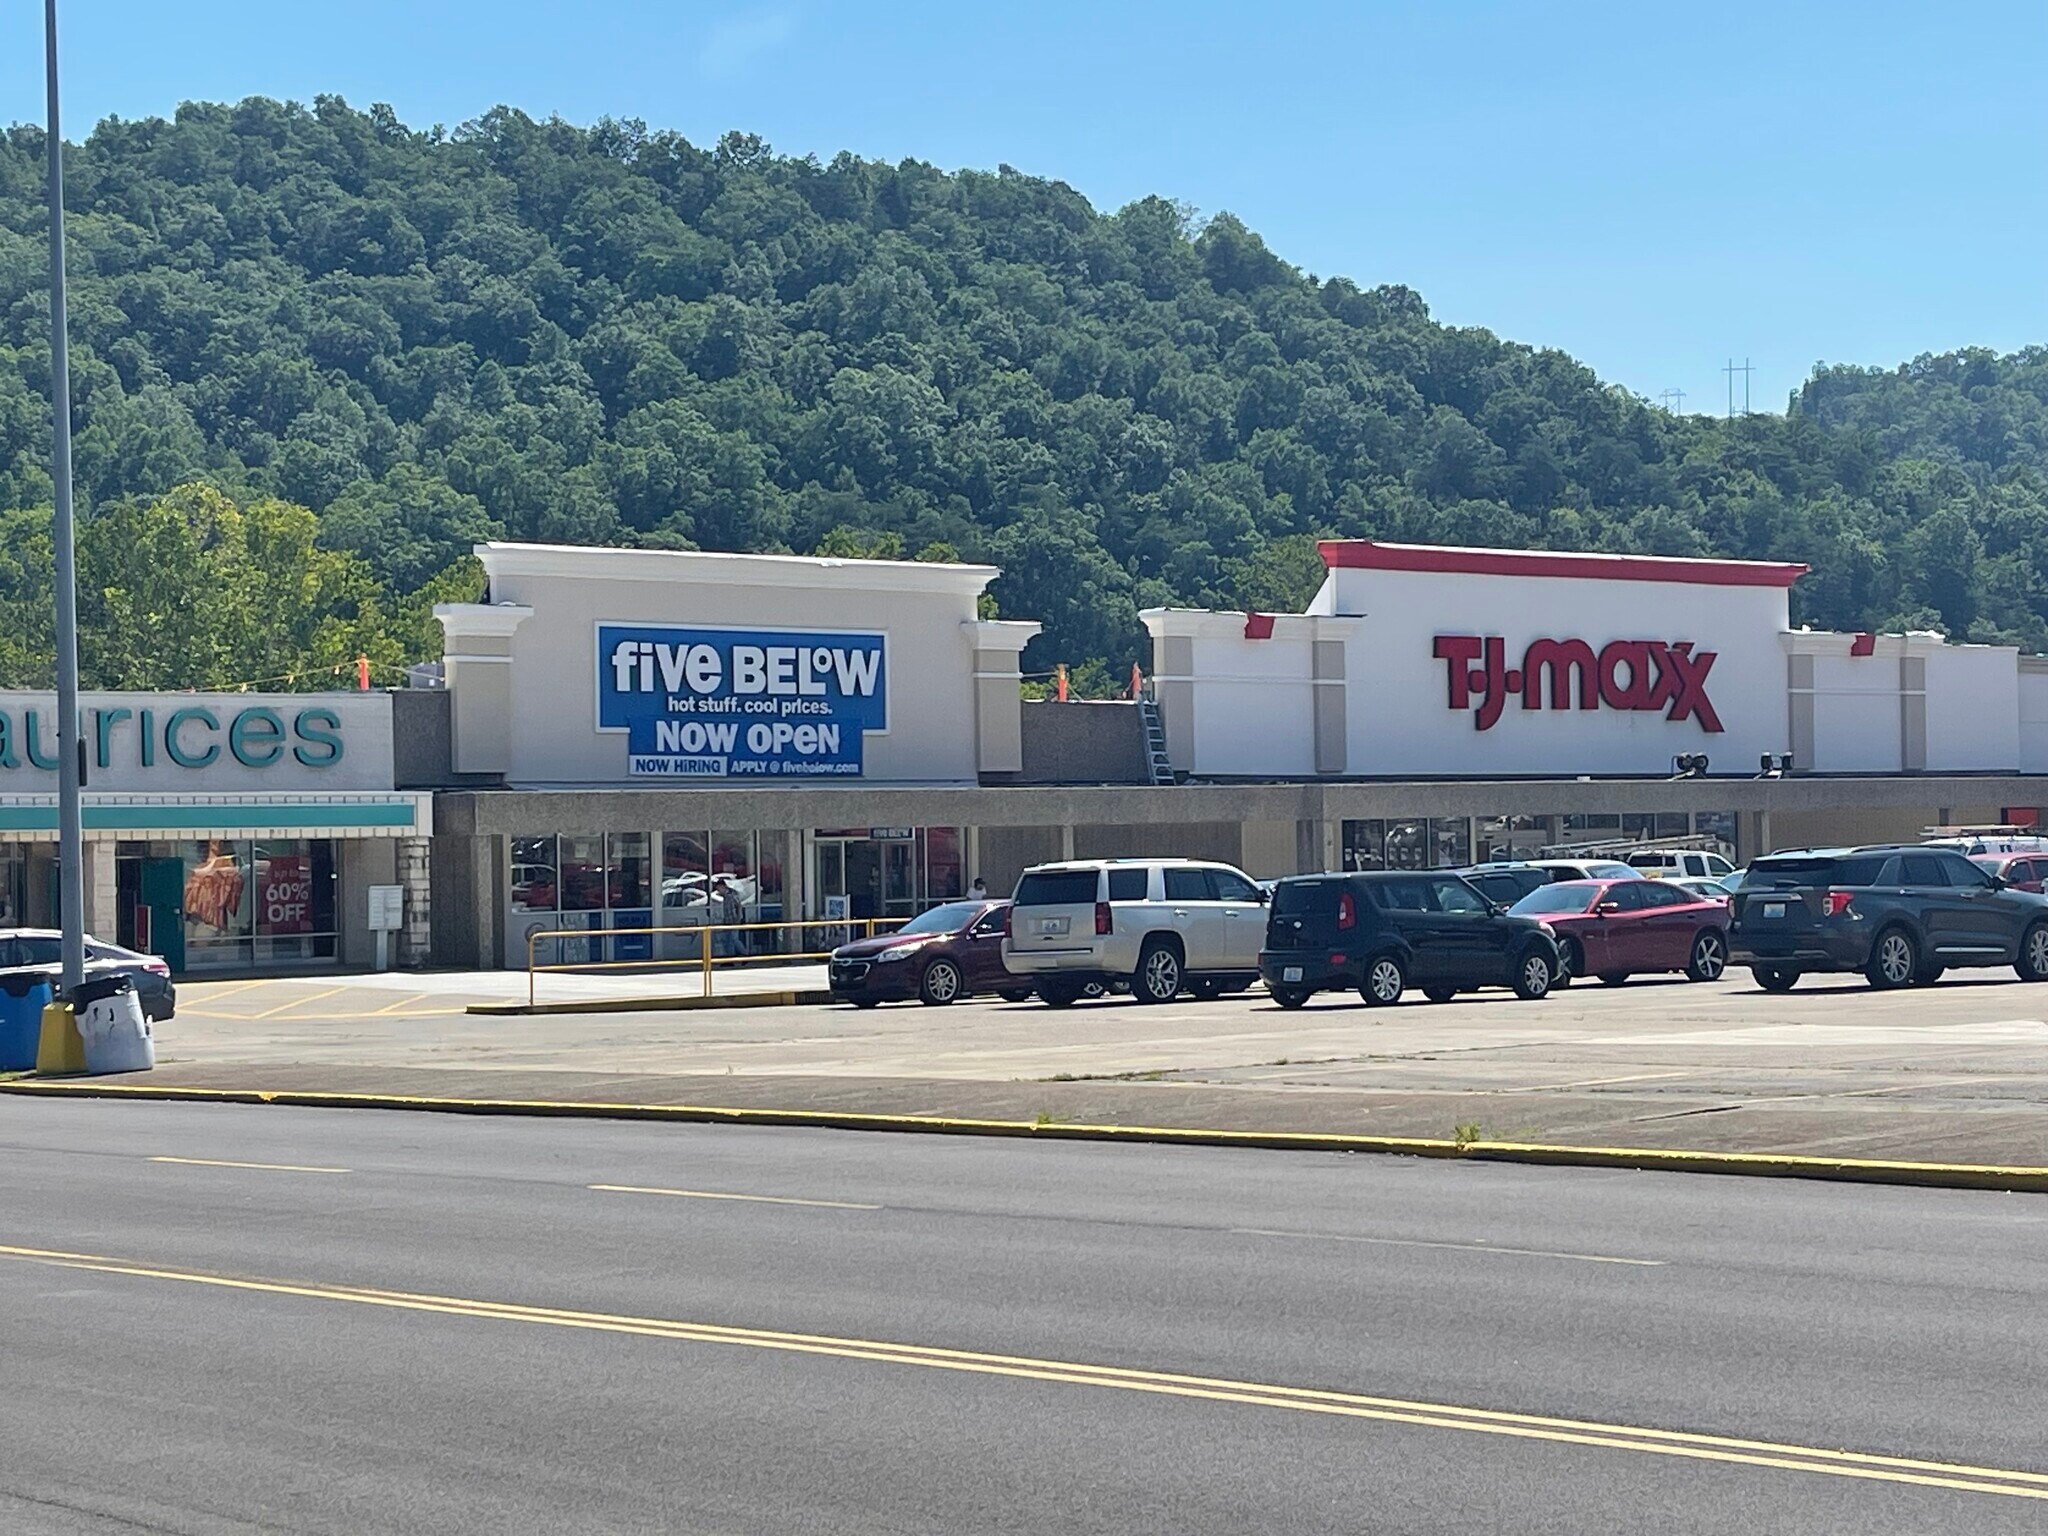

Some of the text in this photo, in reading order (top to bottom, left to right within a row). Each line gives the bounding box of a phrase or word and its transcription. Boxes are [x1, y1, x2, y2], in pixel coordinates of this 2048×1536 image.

[668, 696, 833, 717] hot stuff. cool prices.
[656, 720, 738, 753] NOW
[635, 758, 671, 772] NOW
[731, 761, 767, 773] APPLY
[769, 761, 780, 773] @
[266, 883, 309, 901] 60%
[268, 904, 305, 922] OFF
